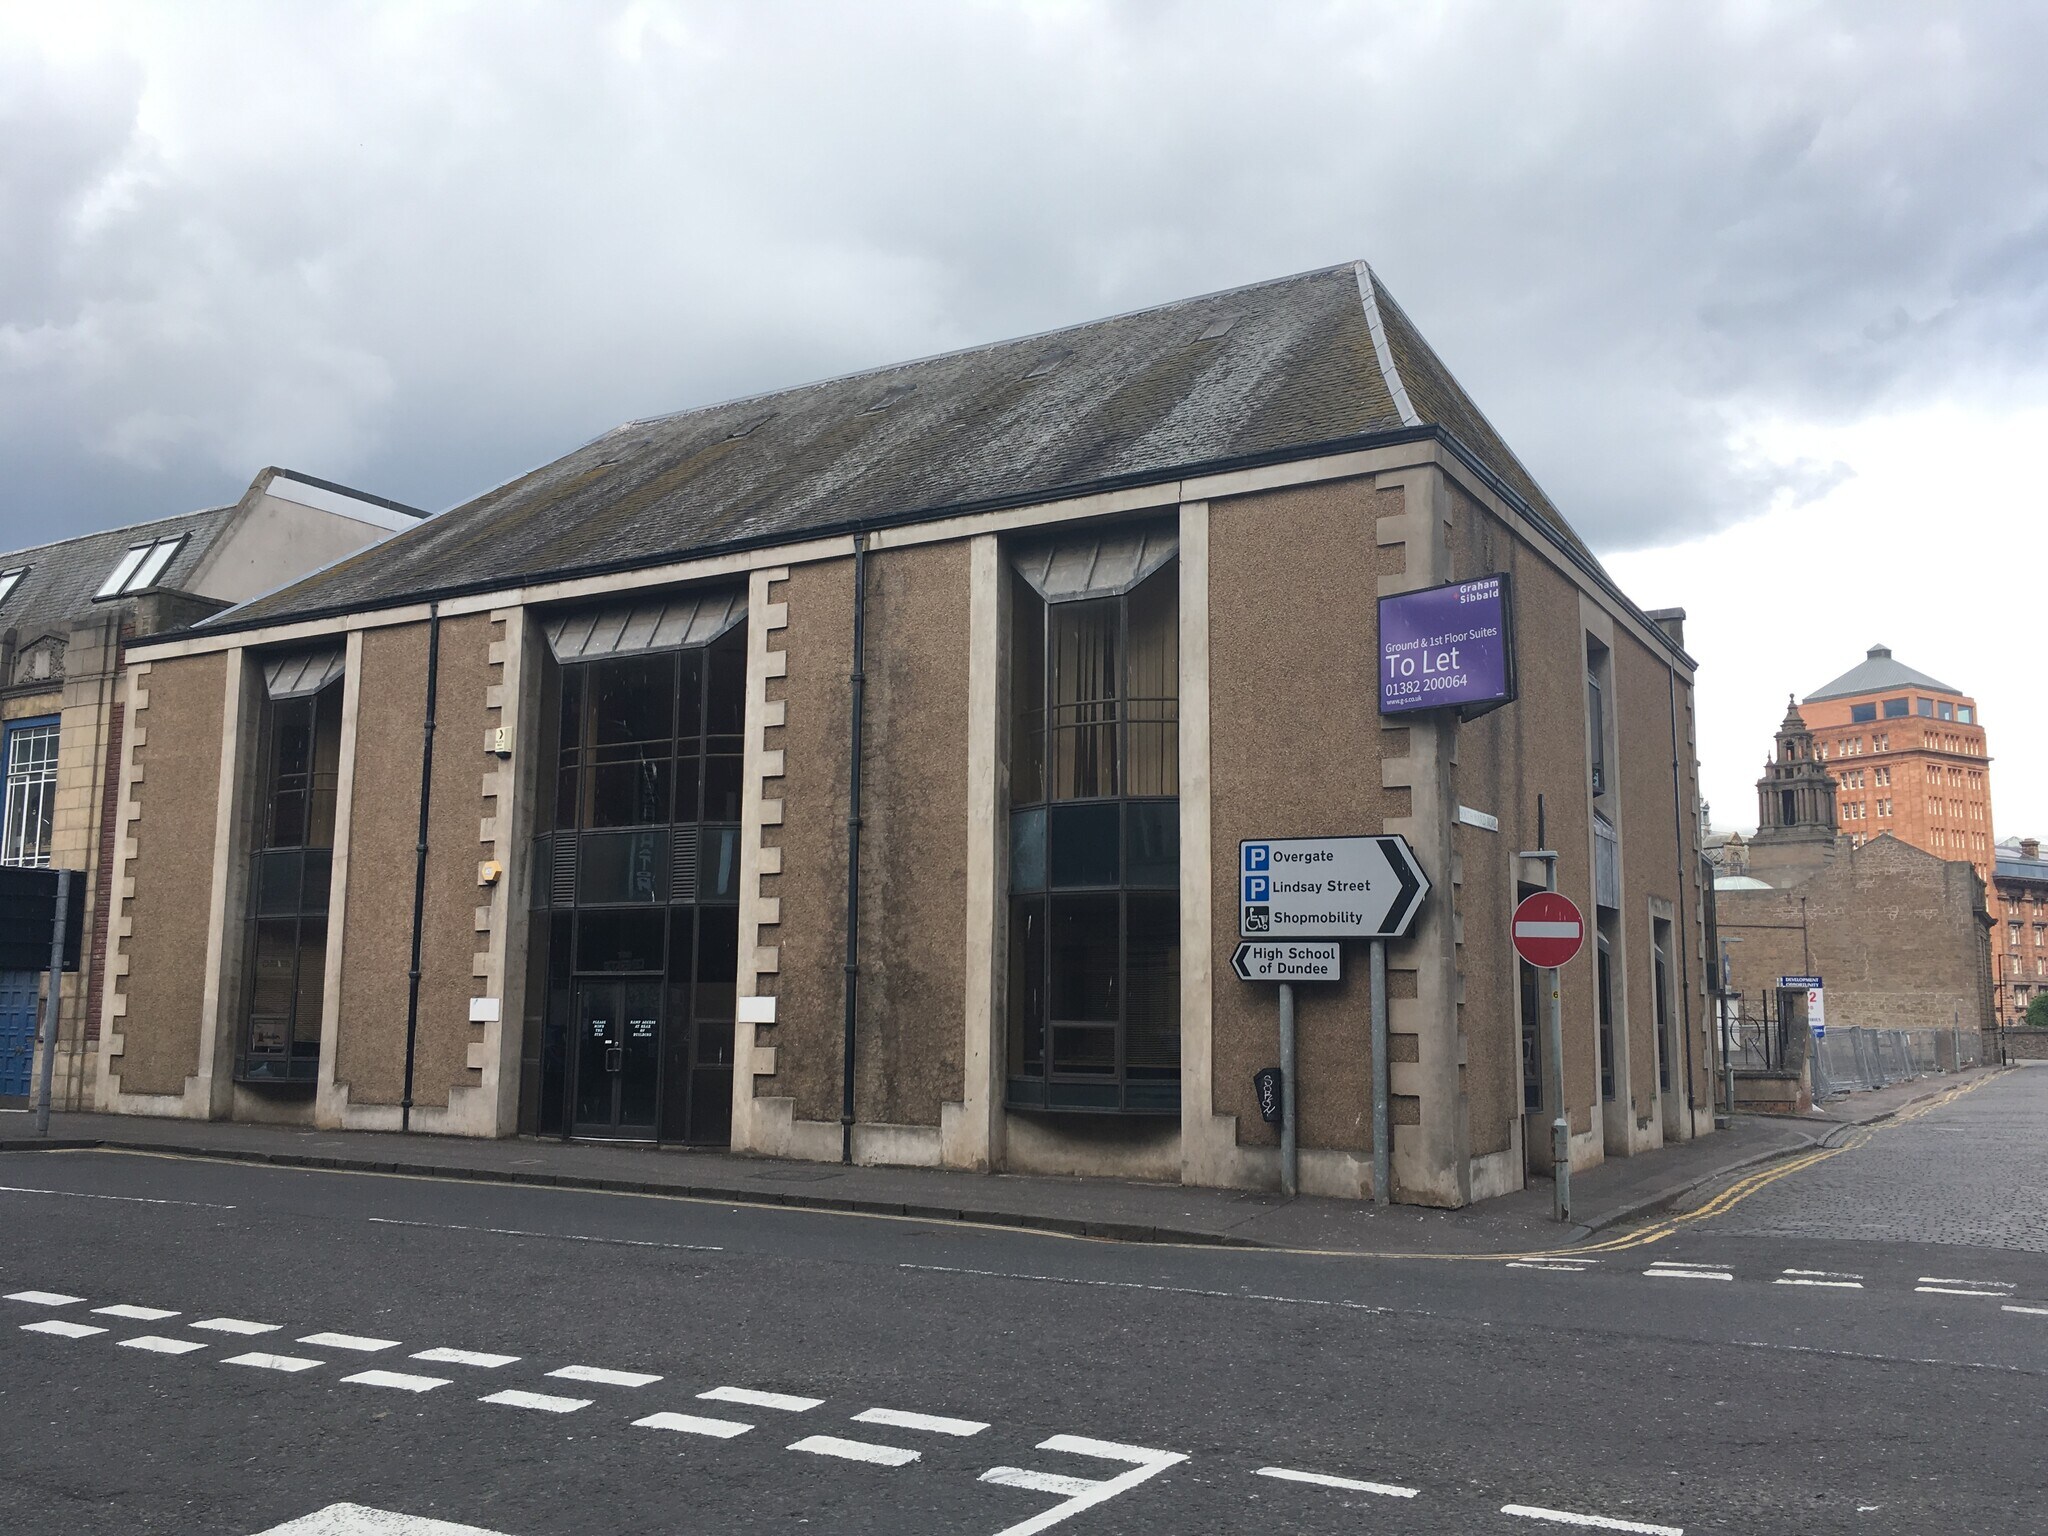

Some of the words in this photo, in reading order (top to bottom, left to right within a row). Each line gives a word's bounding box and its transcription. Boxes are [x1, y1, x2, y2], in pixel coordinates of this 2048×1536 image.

[1460, 580, 1499, 594] Graham
[1460, 588, 1499, 604] Sibbald
[1385, 638, 1419, 653] Ground
[1420, 637, 1428, 648] &
[1429, 635, 1443, 647] 1st
[1444, 632, 1468, 644] Floor
[1469, 627, 1497, 640] Suites
[1385, 654, 1415, 678] To
[1423, 646, 1460, 674] Let
[1385, 680, 1420, 697] 01382
[1423, 674, 1468, 691] 200064
[1273, 851, 1334, 864] Overgate
[1273, 881, 1322, 894] Lindsay
[1327, 880, 1371, 892] Street
[1274, 912, 1363, 925] Shopmobility
[1253, 948, 1283, 961] High
[1288, 947, 1335, 960] School
[1259, 963, 1272, 974] of
[1277, 963, 1328, 974] Dundee
